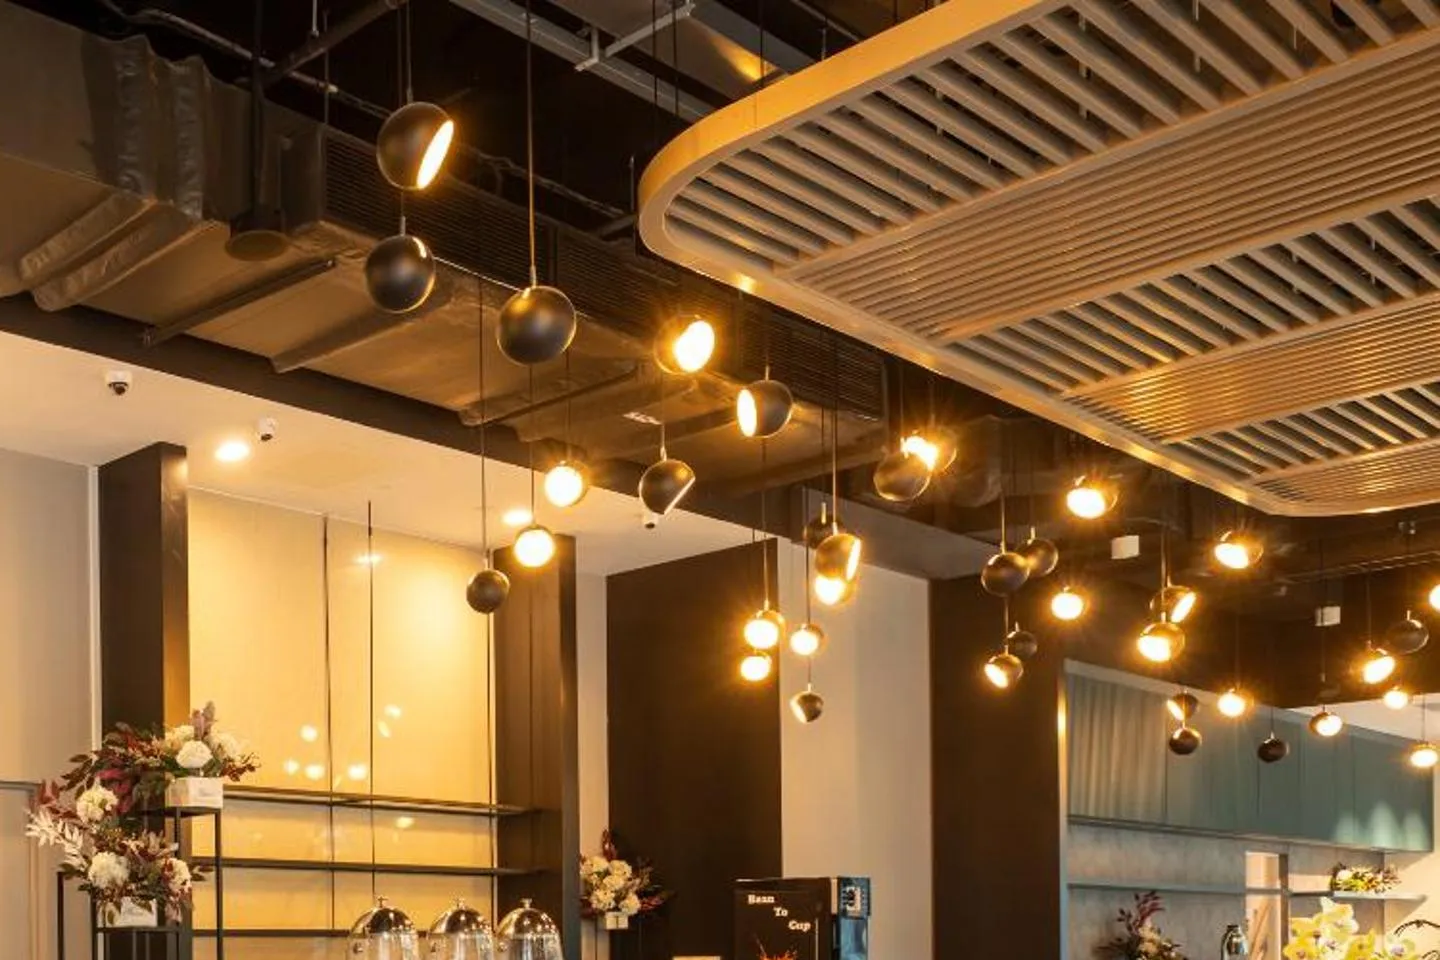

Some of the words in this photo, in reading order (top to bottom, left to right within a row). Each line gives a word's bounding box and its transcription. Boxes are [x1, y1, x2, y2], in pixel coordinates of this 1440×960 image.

[747, 894, 775, 905] Bean
[773, 906, 789, 917] To
[788, 920, 812, 933] Cup
